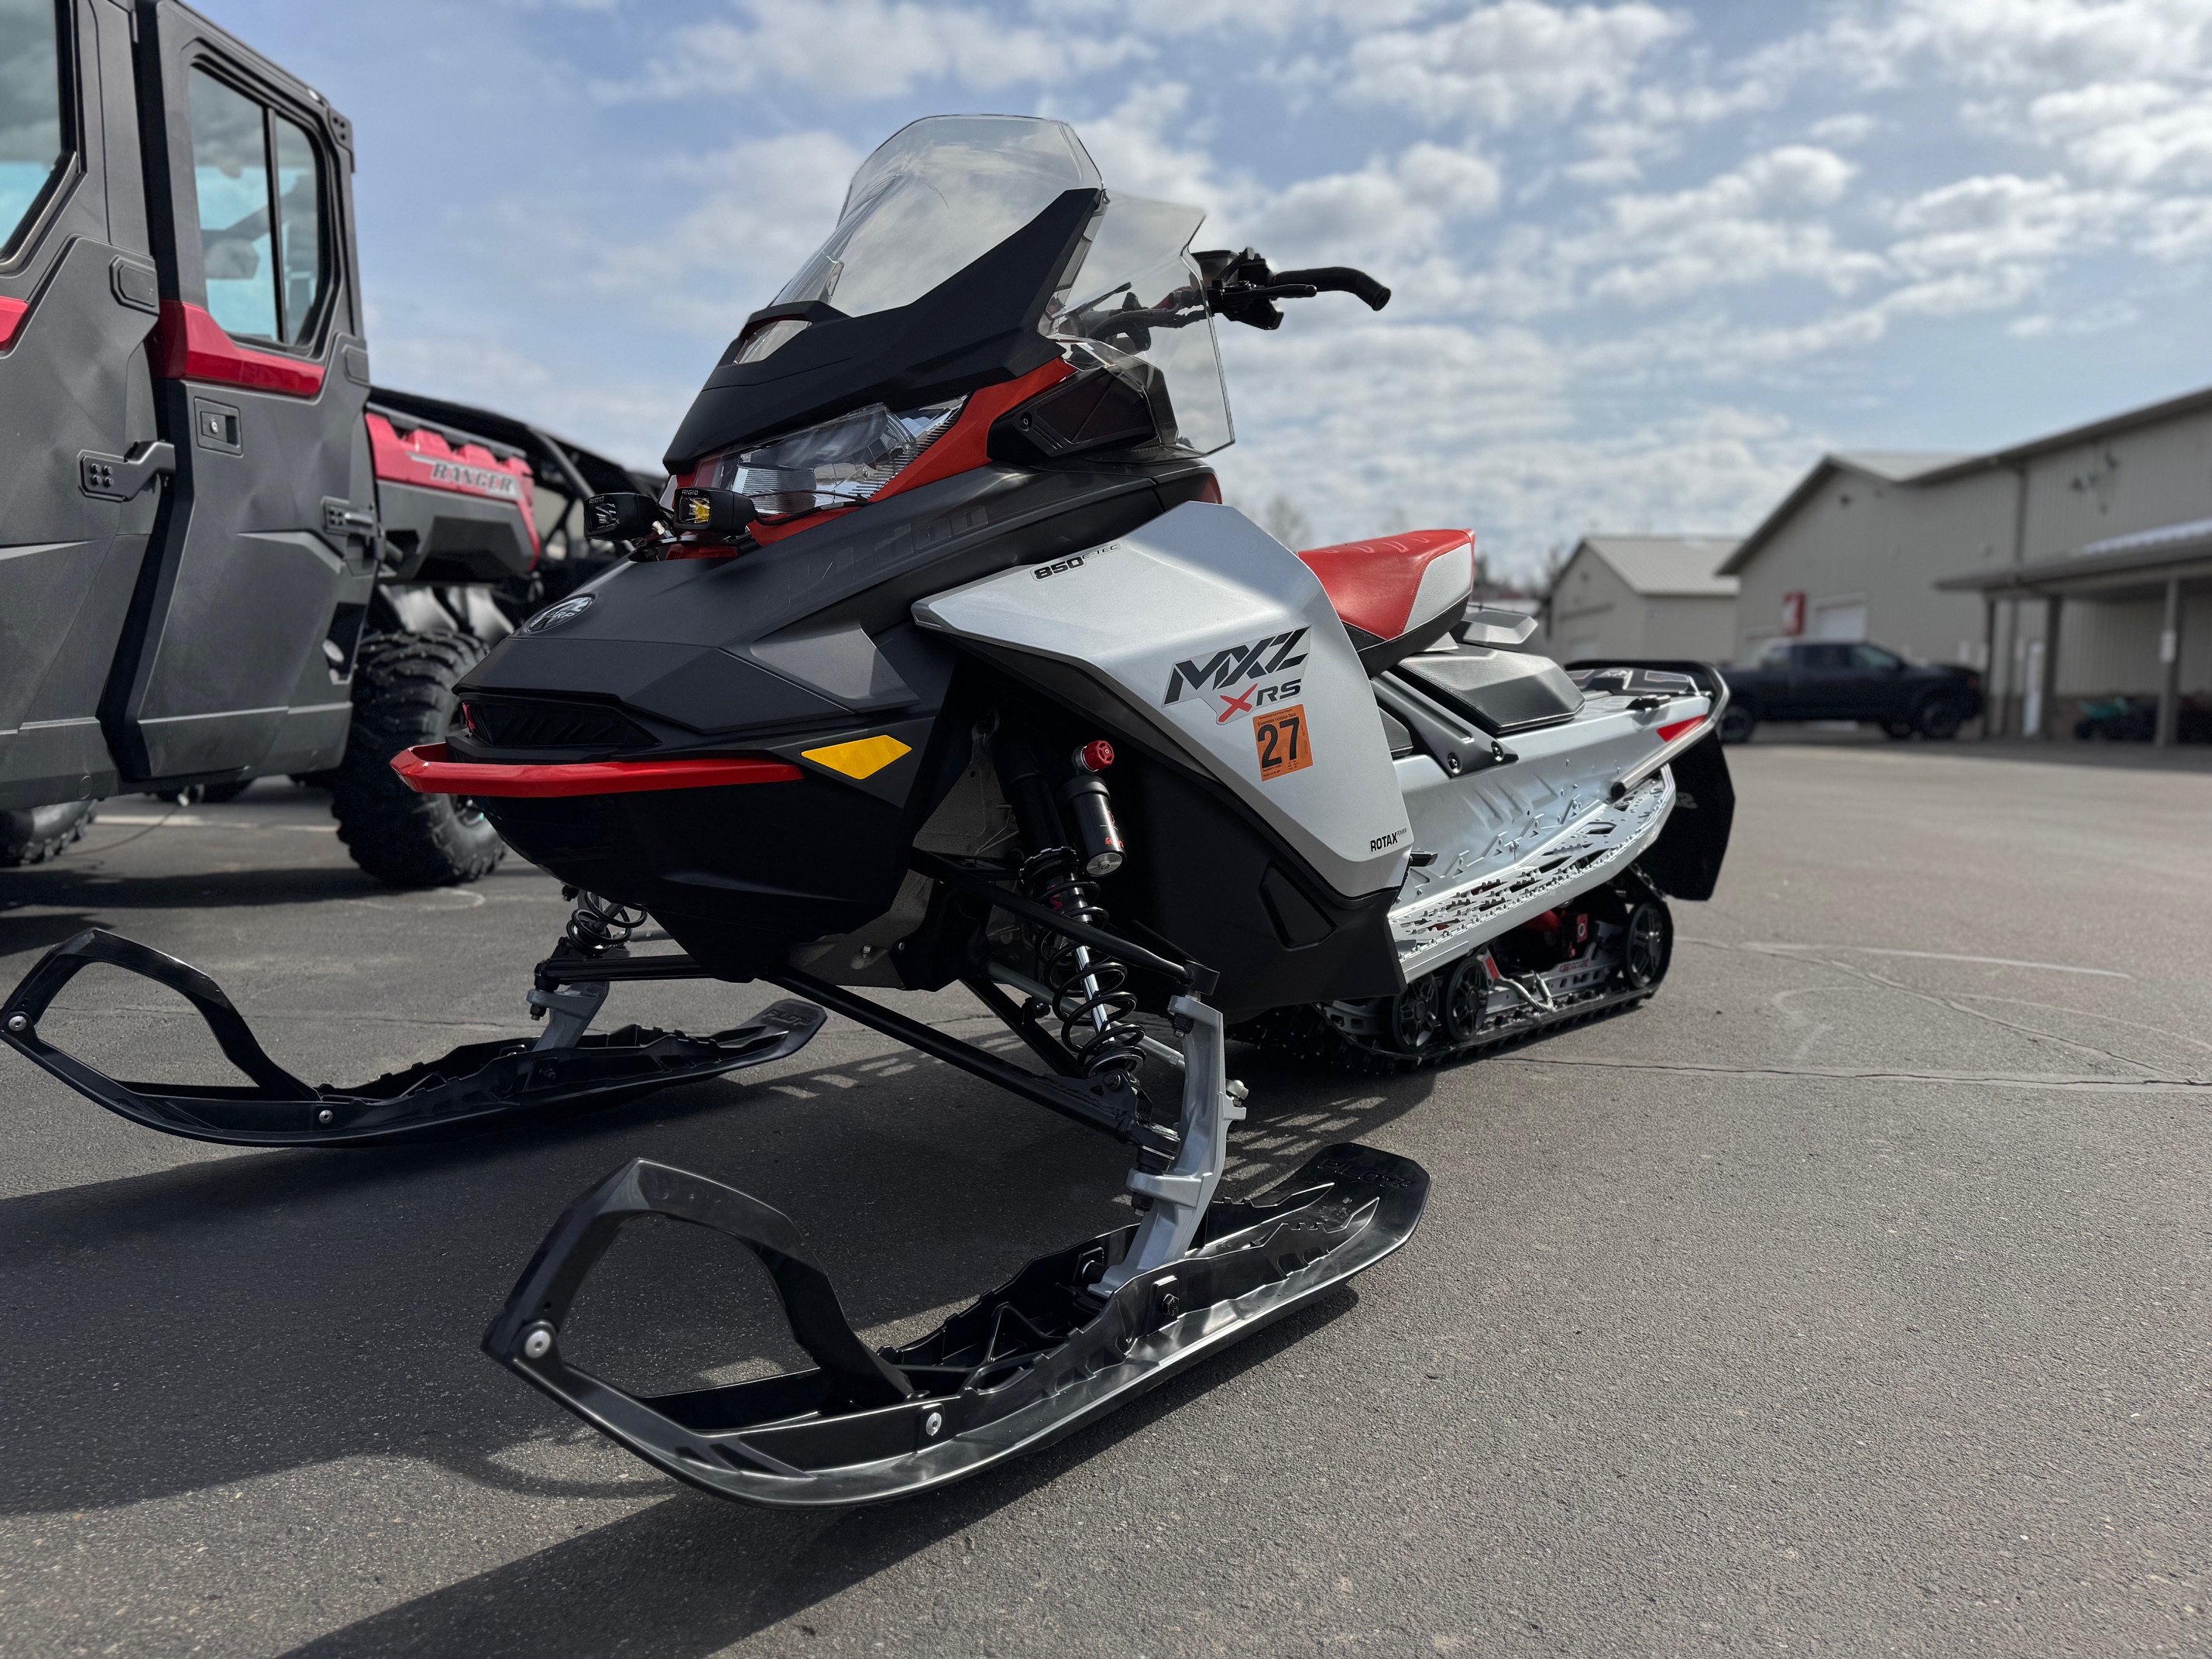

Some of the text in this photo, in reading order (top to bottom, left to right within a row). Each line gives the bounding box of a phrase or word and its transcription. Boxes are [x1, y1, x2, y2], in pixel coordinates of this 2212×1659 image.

[433, 463, 512, 492] RANGER
[589, 496, 605, 504] RIGID
[1034, 544, 1118, 579] 850 E-TEC
[1164, 626, 1310, 705] MXZ
[1258, 716, 1300, 768] 27
[1370, 832, 1397, 852] ROTAX
